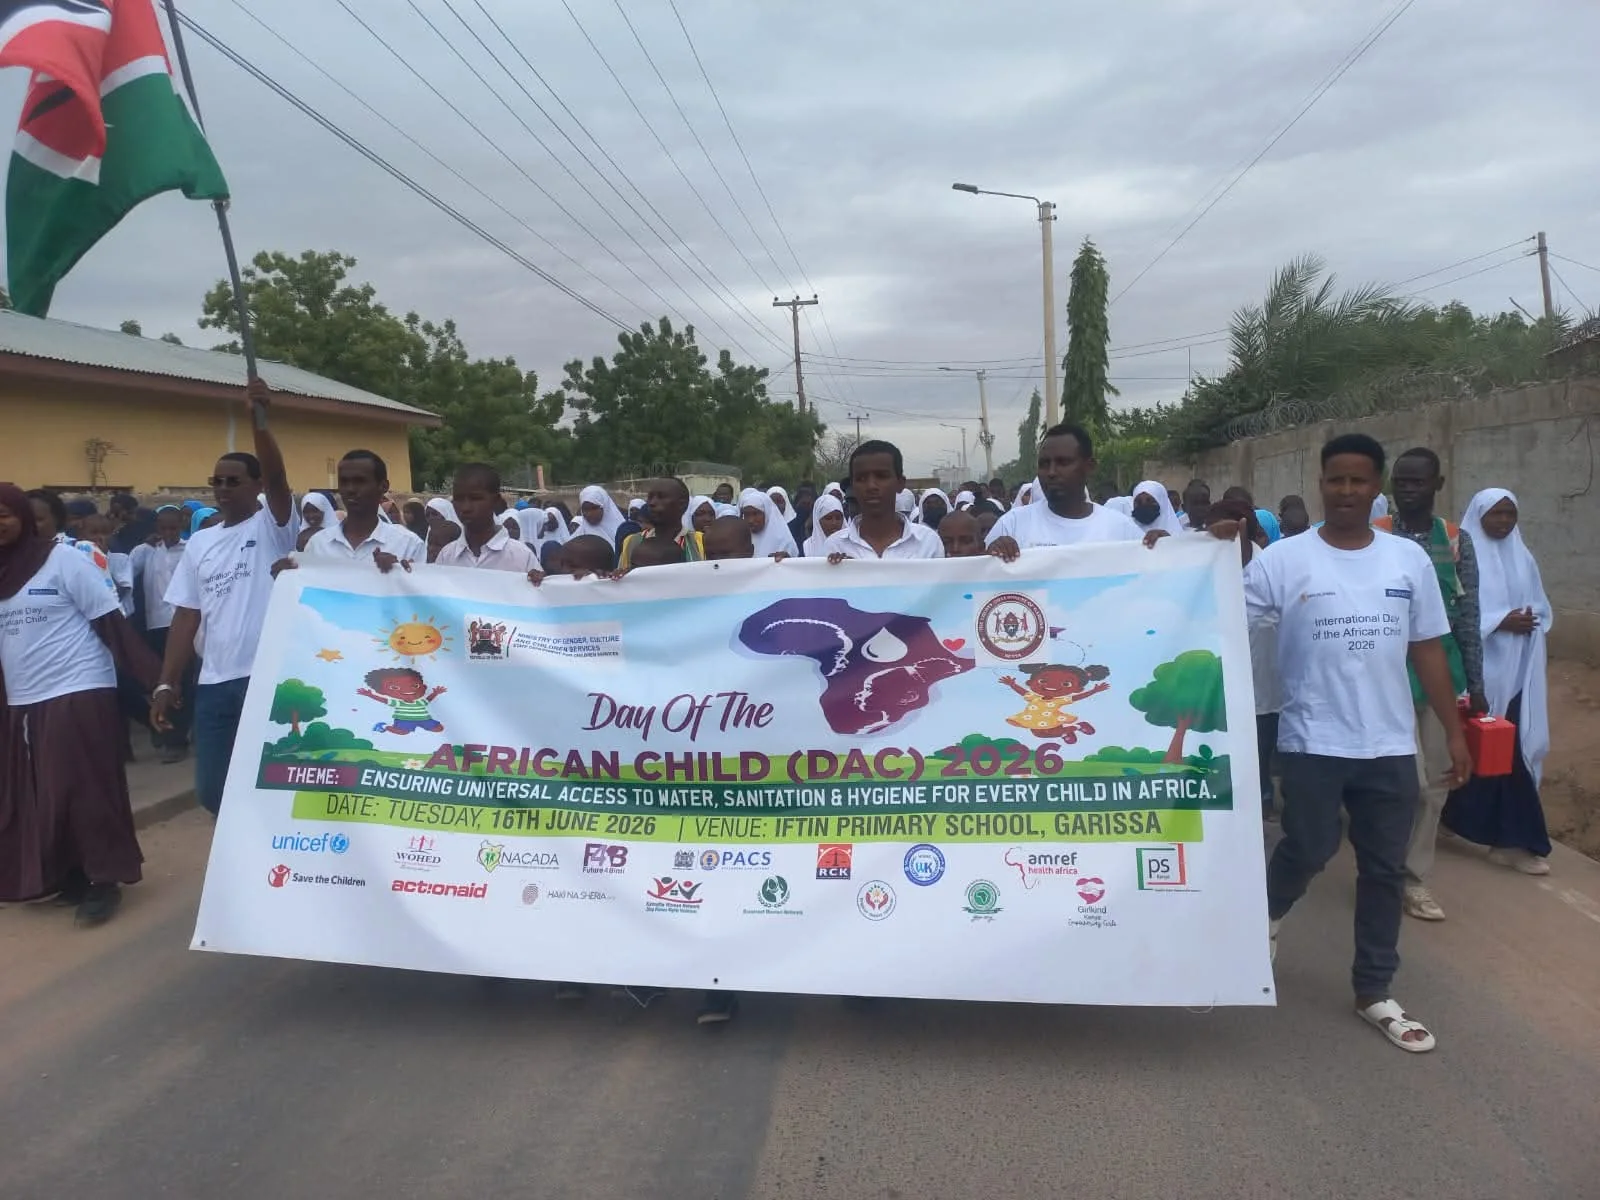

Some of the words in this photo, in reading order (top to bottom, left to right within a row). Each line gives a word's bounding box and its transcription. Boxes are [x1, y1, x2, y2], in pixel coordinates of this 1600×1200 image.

[25, 616, 48, 624] Child
[1314, 614, 1380, 627] International
[1382, 613, 1400, 625] Day
[1312, 632, 1322, 641] of
[1323, 629, 1340, 639] the
[1343, 627, 1380, 638] African
[1348, 640, 1375, 650] 2026
[581, 692, 656, 742] Day
[662, 693, 714, 742] Of
[716, 691, 774, 732] The
[424, 743, 620, 780] AFRICAN
[634, 750, 770, 782] CHILD
[786, 746, 925, 784] (DAC)
[941, 742, 1064, 777] 2026
[287, 766, 340, 785] THEME:
[360, 769, 453, 796] ENSURING
[457, 779, 552, 800] UNIVERSAL
[557, 785, 627, 805] ACCESS
[632, 788, 655, 805] TO
[658, 788, 719, 809] WATER,
[723, 788, 825, 808] SANITATION
[831, 787, 842, 806] &
[848, 786, 927, 806] HYGIENE
[932, 785, 970, 804] FOR
[975, 783, 1040, 803] EVERY
[1046, 782, 1107, 802] CHILD
[1112, 781, 1132, 801] IN
[1138, 778, 1217, 800] AFRICA.
[326, 794, 380, 817] DATE:
[389, 799, 484, 831] TUESDAY,
[492, 809, 540, 831] 16TH
[545, 809, 599, 832] JUNE
[605, 814, 656, 836] 2026
[695, 816, 768, 838] VENUE:
[774, 816, 838, 837] IFTIN
[840, 814, 937, 837] PRIMARY
[945, 813, 1046, 839] SCHOOL,
[1054, 812, 1162, 836] GARISSA
[272, 831, 330, 853] unicef
[396, 851, 441, 864] WOHED
[501, 851, 560, 866] NACADA
[583, 843, 628, 868] F4B
[721, 851, 772, 866] PACS
[1028, 851, 1078, 866] amref
[819, 868, 849, 877] RCK
[1028, 866, 1054, 875] health
[1055, 867, 1078, 876] africa
[1148, 858, 1170, 879] ps
[292, 872, 314, 883] Save
[315, 874, 330, 884] the
[331, 874, 366, 887] Children
[548, 890, 567, 899] HAKI
[580, 891, 607, 900] SHERIA
[1077, 905, 1107, 914] Girlkind
